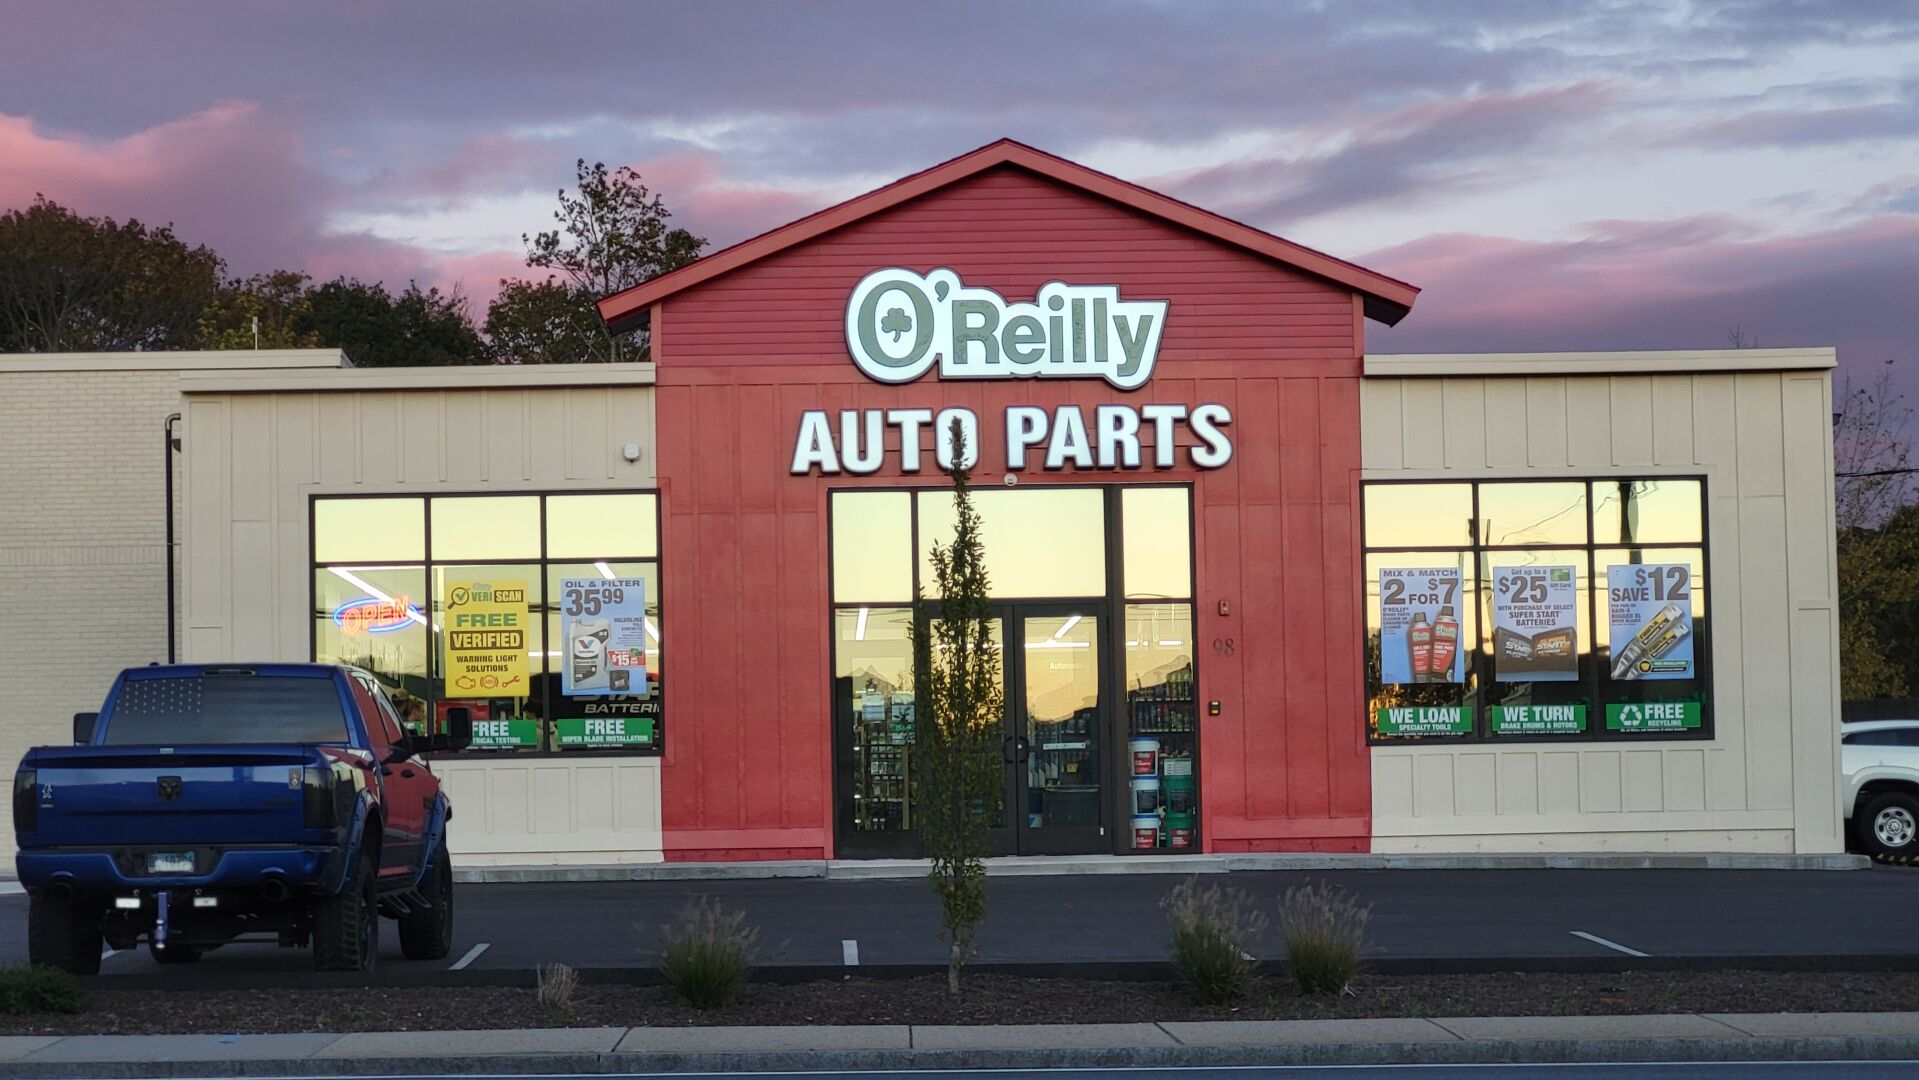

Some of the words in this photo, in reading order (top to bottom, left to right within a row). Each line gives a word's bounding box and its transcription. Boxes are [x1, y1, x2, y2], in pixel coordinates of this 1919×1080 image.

[857, 279, 1154, 378] O'Reilly
[789, 407, 979, 475] AUTO
[1004, 403, 1234, 471] PARTS
[1384, 578, 1406, 605] 2
[1408, 593, 1440, 605] FOR
[1427, 577, 1459, 604] $7
[1498, 575, 1548, 603] $25
[1611, 587, 1649, 601] SAVE
[1635, 566, 1689, 601] $12
[471, 592, 493, 602] VERI
[496, 590, 522, 602] SCAN
[343, 593, 411, 636] OPEN
[456, 613, 518, 627] FREE
[452, 632, 521, 648] VERIFIED
[1212, 638, 1234, 657] 98
[456, 655, 493, 663] WARNING
[611, 654, 630, 666] $15
[465, 664, 509, 673] SOLUTIONS
[584, 703, 660, 714] BATTERI
[1388, 707, 1414, 724] WE
[1419, 707, 1461, 724] LOAN
[1503, 706, 1529, 722] WE
[1532, 705, 1575, 721] TURN
[1644, 703, 1684, 719] FREE
[472, 721, 509, 737] FREE
[585, 719, 625, 735] FREE
[1432, 723, 1452, 731] TOOLS
